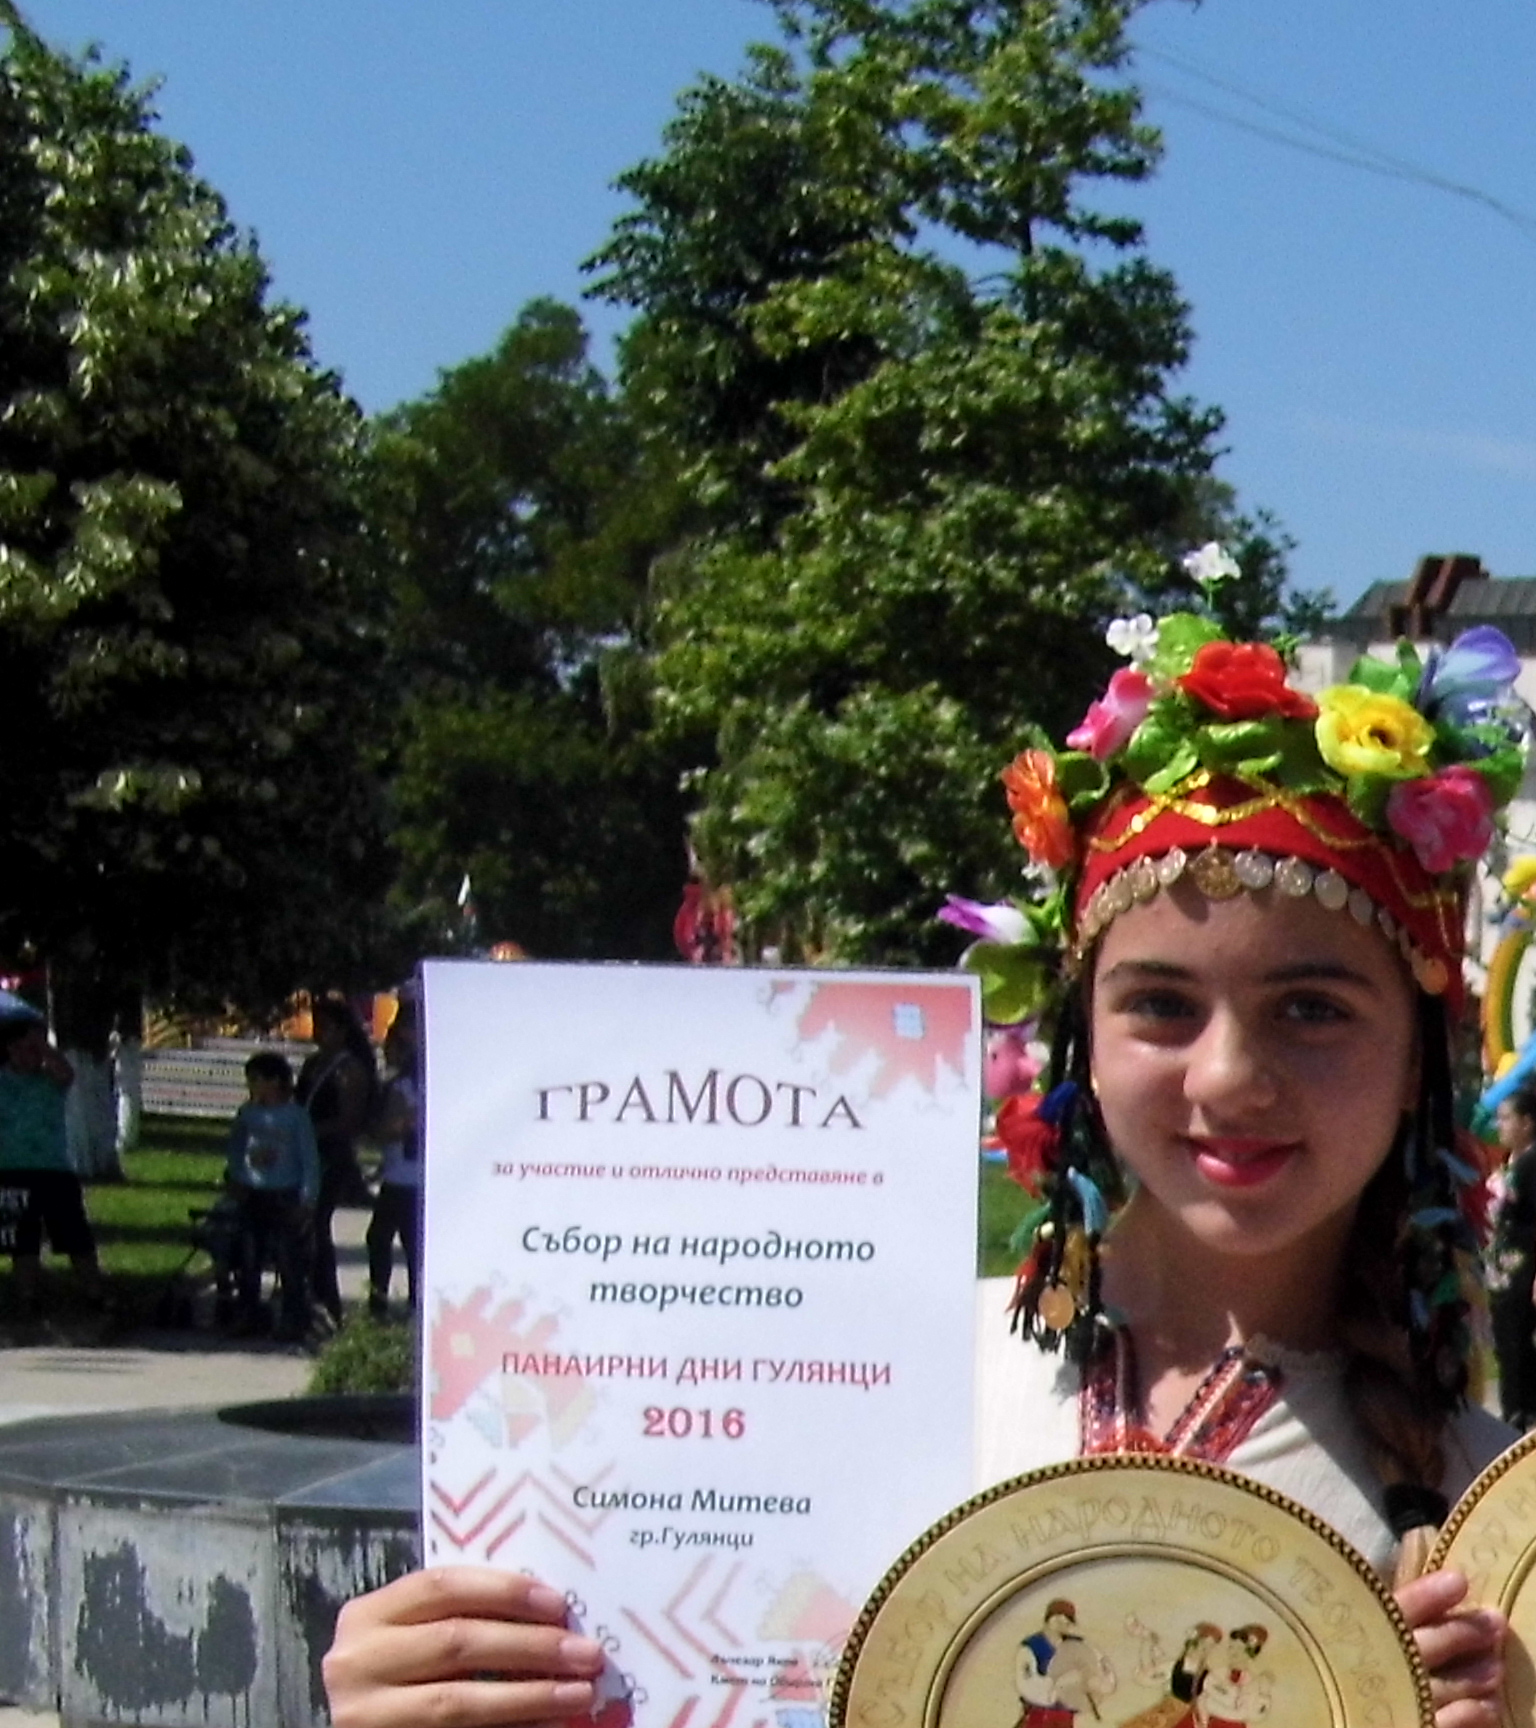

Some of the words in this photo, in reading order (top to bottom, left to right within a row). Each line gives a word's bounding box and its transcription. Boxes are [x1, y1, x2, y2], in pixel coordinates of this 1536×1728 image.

[535, 1067, 864, 1129] ГРАМОТА
[492, 1161, 515, 1177] за
[518, 1161, 607, 1181] участие
[610, 1164, 625, 1180] и
[627, 1164, 724, 1182] отлично
[726, 1164, 869, 1187] представяне
[871, 1170, 885, 1187] в
[521, 1225, 623, 1263] Събор
[632, 1235, 671, 1256] на
[680, 1230, 876, 1266] народното
[589, 1282, 804, 1313] творчество
[502, 1352, 668, 1379] ПАНАИРНИ
[675, 1357, 742, 1387] ДНИ
[752, 1359, 891, 1392] ГУЛЯНЦИ
[642, 1406, 746, 1440] 2016
[572, 1485, 683, 1512] Симона
[690, 1488, 811, 1515] Митева
[1011, 1496, 1281, 1563] НАРОДНОТО
